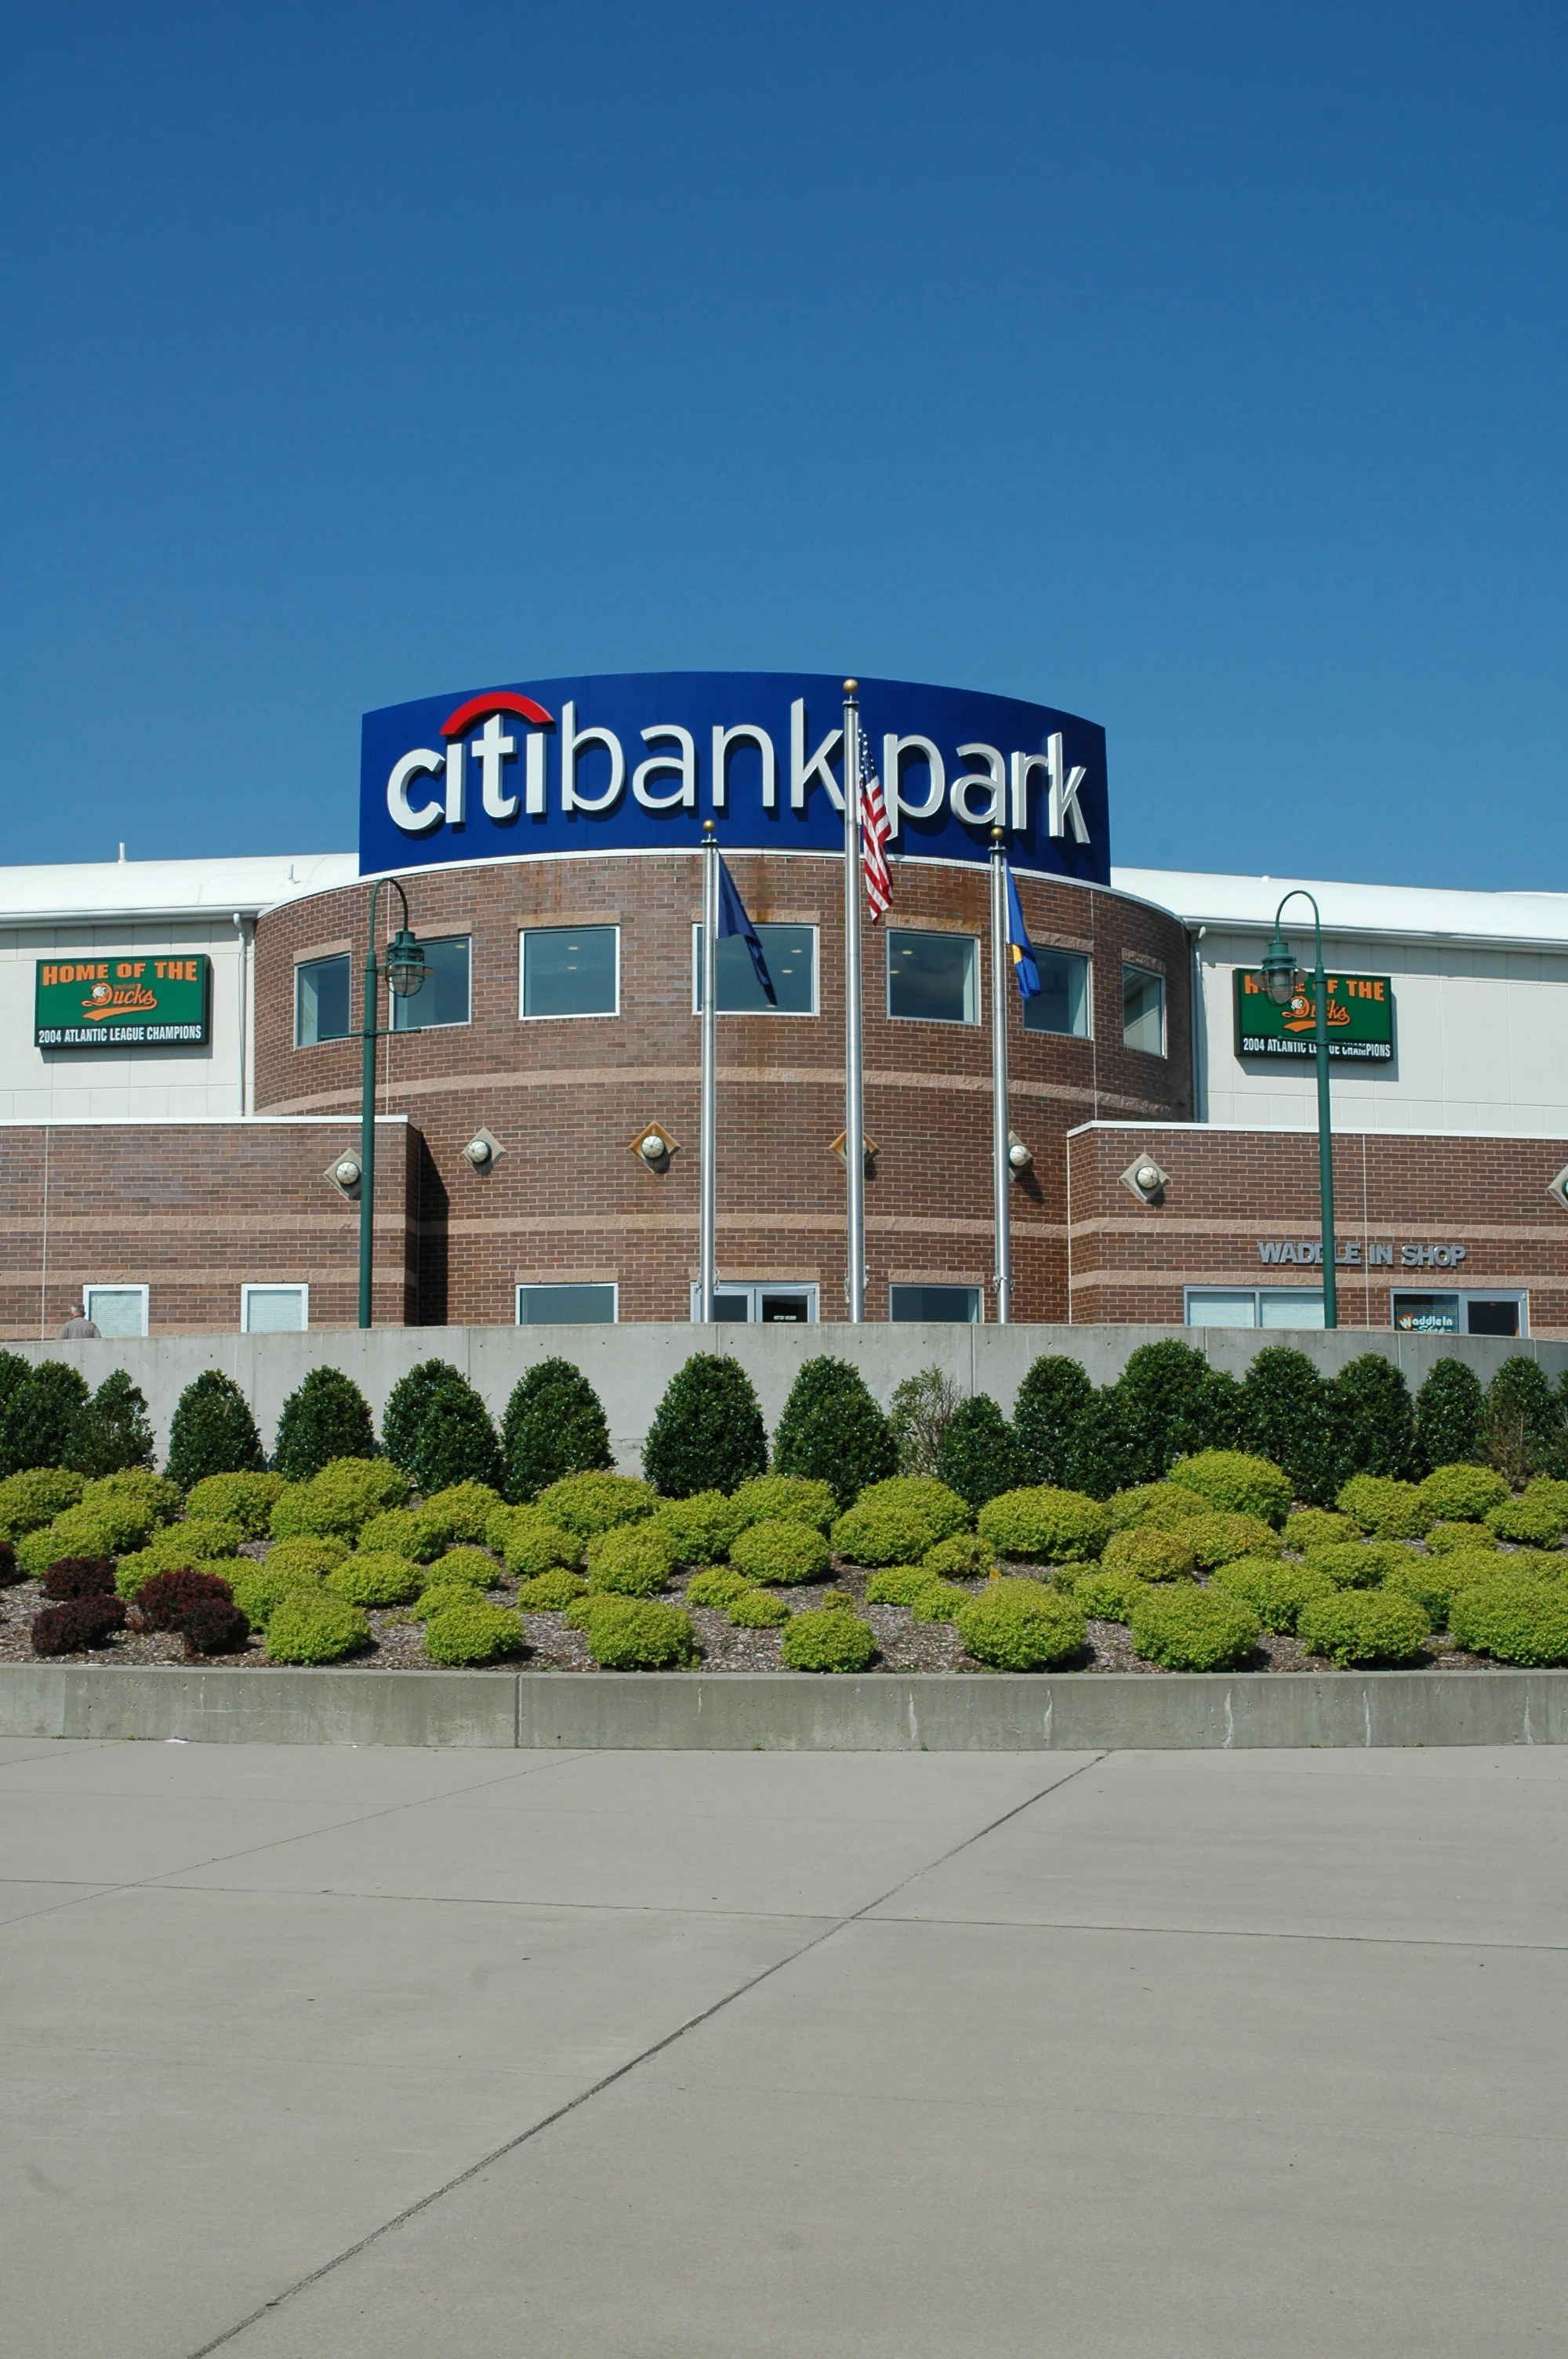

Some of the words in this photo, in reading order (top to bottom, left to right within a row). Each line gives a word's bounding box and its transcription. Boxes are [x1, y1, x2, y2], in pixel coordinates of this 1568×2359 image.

[387, 692, 846, 831] citibank
[883, 732, 1091, 845] park
[42, 964, 109, 986] HOME
[116, 962, 146, 978] OF
[154, 961, 198, 981] THE
[81, 982, 158, 1009] Ducks
[1345, 980, 1385, 1001] THE
[38, 1029, 62, 1043] 2004
[64, 1028, 107, 1042] ATLANTIC
[110, 1027, 144, 1041] LEAGUE
[147, 1025, 201, 1040] CHAMPIONS
[1243, 1038, 1265, 1051] 2004
[1267, 1038, 1307, 1053] ATLANTIC
[1308, 1042, 1340, 1055] LEUE
[1369, 1244, 1394, 1265] IN
[1400, 1245, 1466, 1267] SHOP
